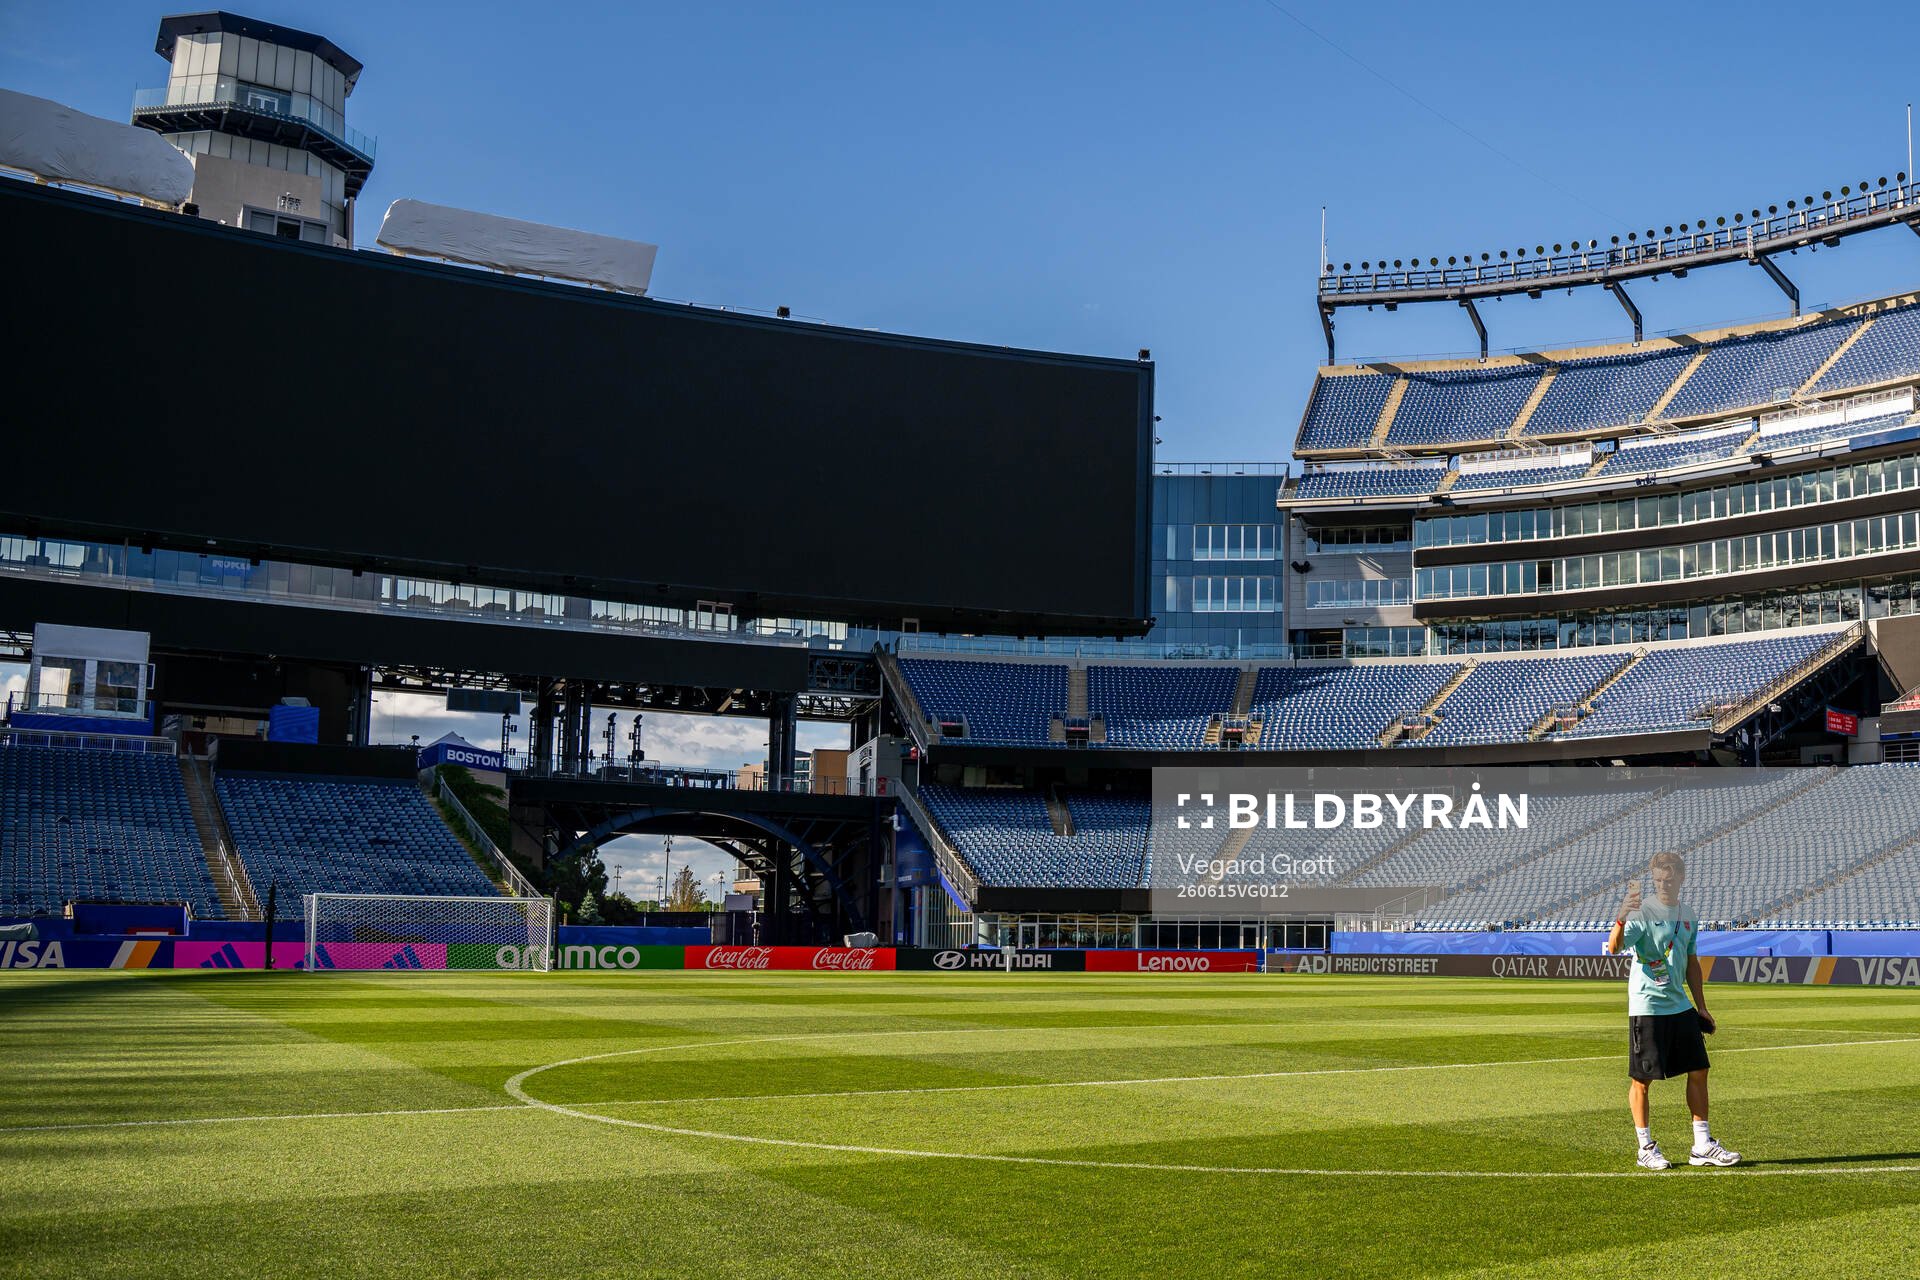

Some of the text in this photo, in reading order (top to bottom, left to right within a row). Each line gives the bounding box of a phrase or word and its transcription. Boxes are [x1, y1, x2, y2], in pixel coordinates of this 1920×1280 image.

[447, 749, 500, 768] BOSTON
[0, 940, 65, 968] ISA
[705, 946, 773, 969] Coca-Cola
[812, 947, 877, 969] Coca-Cola
[970, 953, 1052, 968] HYUNDAI
[1137, 953, 1210, 972] Lenovo
[1296, 956, 1438, 974] ADI PREDICTSTREET
[1492, 957, 1548, 978] QATAR
[1556, 958, 1632, 978] AIRWAYS
[1728, 957, 1789, 983] VISA
[1852, 957, 1920, 986] VISA
